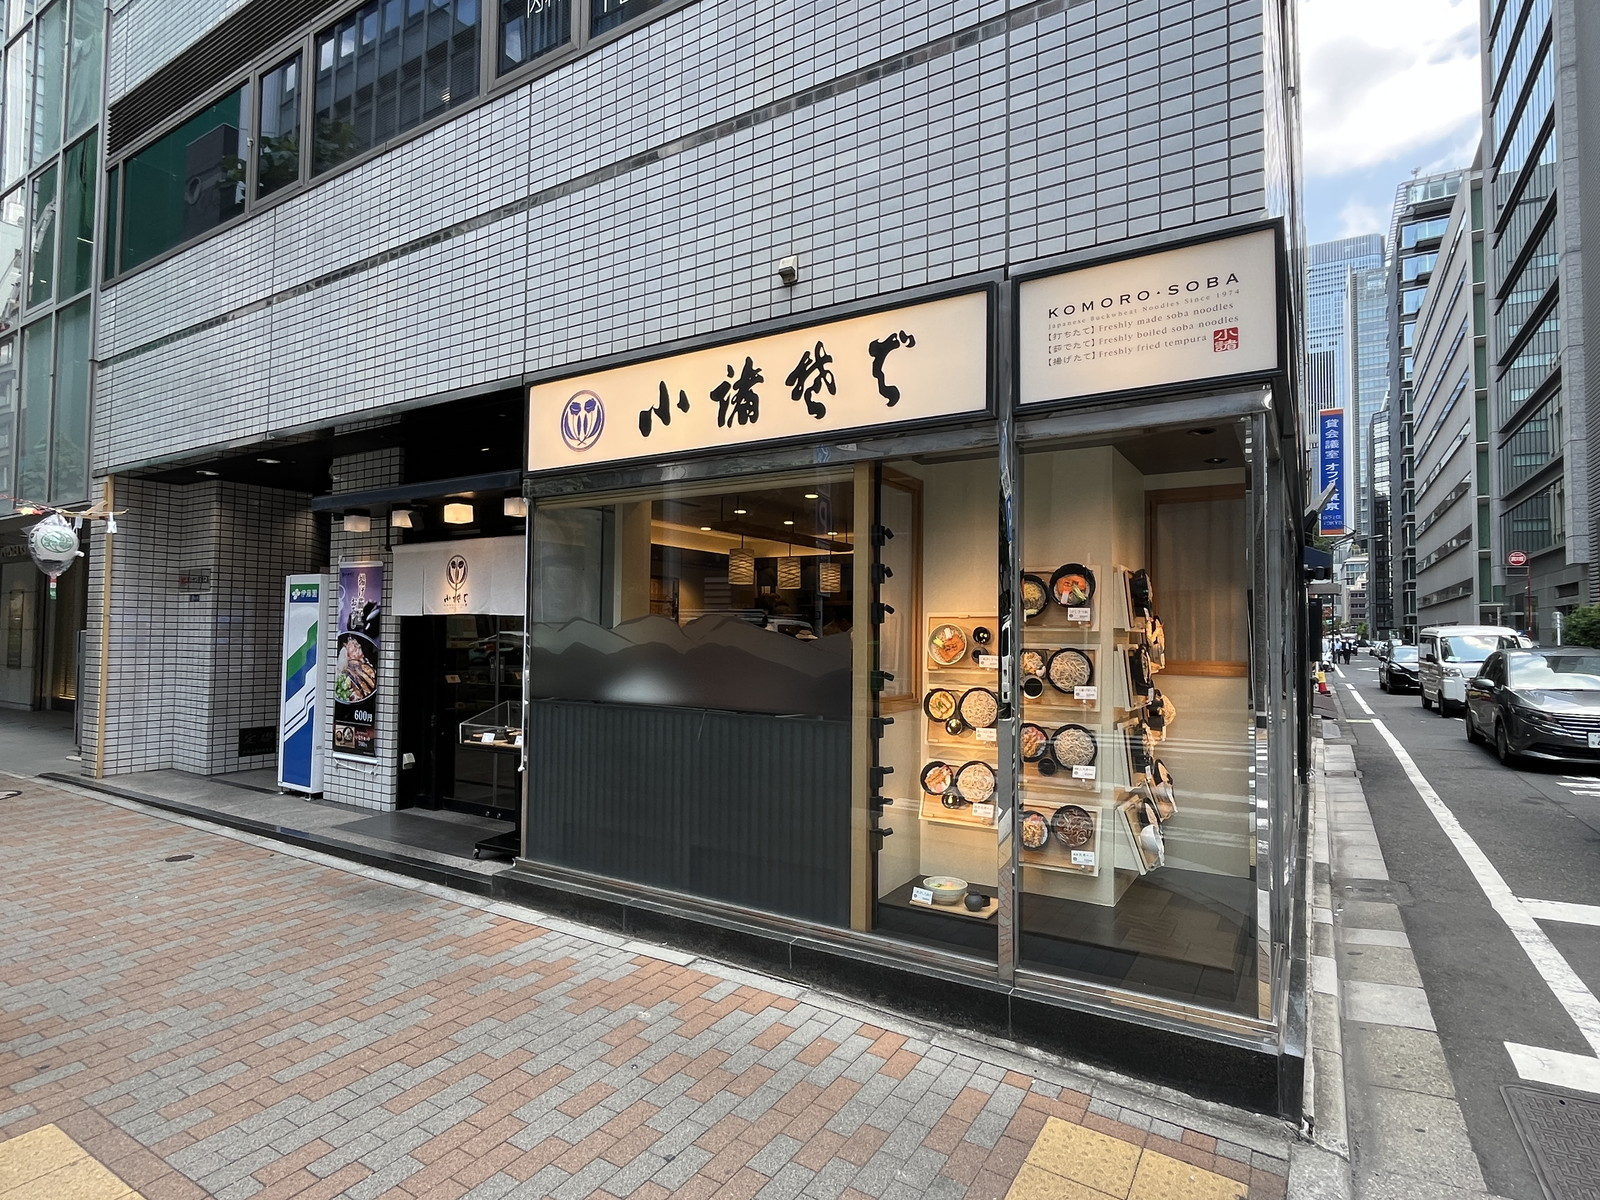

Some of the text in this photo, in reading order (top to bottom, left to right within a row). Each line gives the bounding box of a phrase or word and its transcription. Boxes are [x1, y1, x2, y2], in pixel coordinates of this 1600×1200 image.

[1048, 289, 1240, 330] Japanese Buckwheat Noodles Since 1974
[1099, 320, 1133, 332] Freshly
[1137, 315, 1163, 325] made
[1166, 311, 1189, 320] soba
[1193, 303, 1234, 315] noodles
[1099, 333, 1133, 345] Freshly
[1137, 327, 1167, 338] boiled
[1171, 323, 1194, 333] soba
[1198, 315, 1239, 328] noodles
[1099, 346, 1133, 358] Freshly
[1137, 341, 1160, 352] fried
[1164, 335, 1207, 347] tempura
[1324, 418, 1340, 460] 貸会議室
